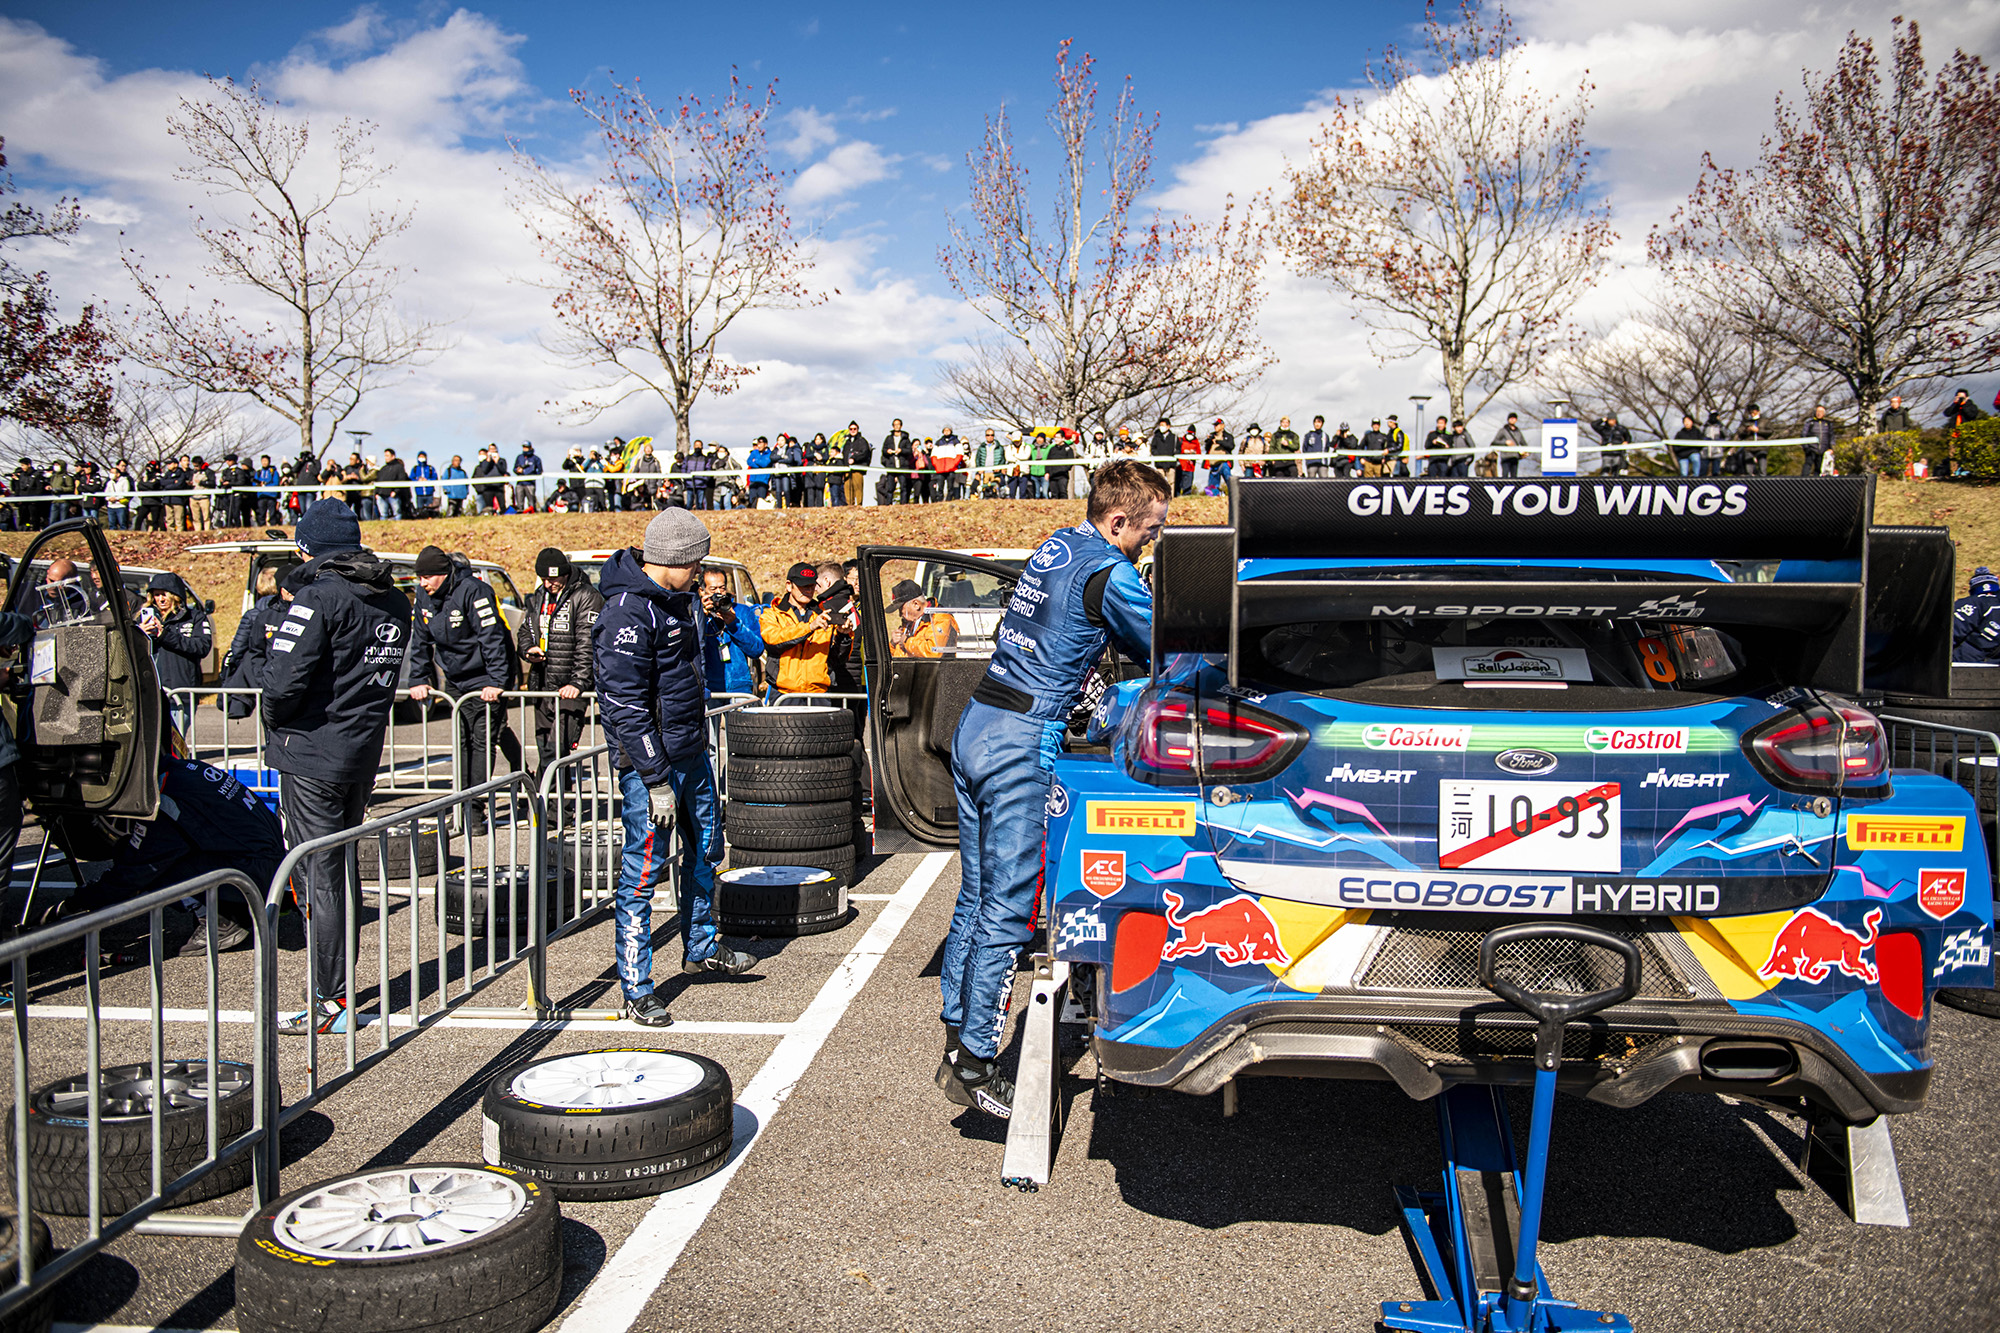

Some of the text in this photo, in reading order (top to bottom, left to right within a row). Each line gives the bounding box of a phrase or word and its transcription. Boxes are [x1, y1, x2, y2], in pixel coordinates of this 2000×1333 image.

[1550, 436, 1569, 459] B
[1346, 484, 1749, 516] GIVES YOU WINGS
[1032, 540, 1062, 569] Ford
[1370, 604, 1618, 618] M-SPORT
[1637, 637, 1677, 684] 8
[1610, 729, 1682, 750] Castrol
[1508, 752, 1544, 769] Ford
[1096, 807, 1186, 829] PIRELLI
[1451, 793, 1473, 839] 三河
[1488, 794, 1610, 840] 10-93
[1856, 822, 1955, 844] PIRELLI
[1338, 876, 1566, 909] ECOBOOST
[1576, 883, 1720, 912] HYBRID
[1082, 925, 1098, 939] M
[1963, 948, 1981, 963] M
